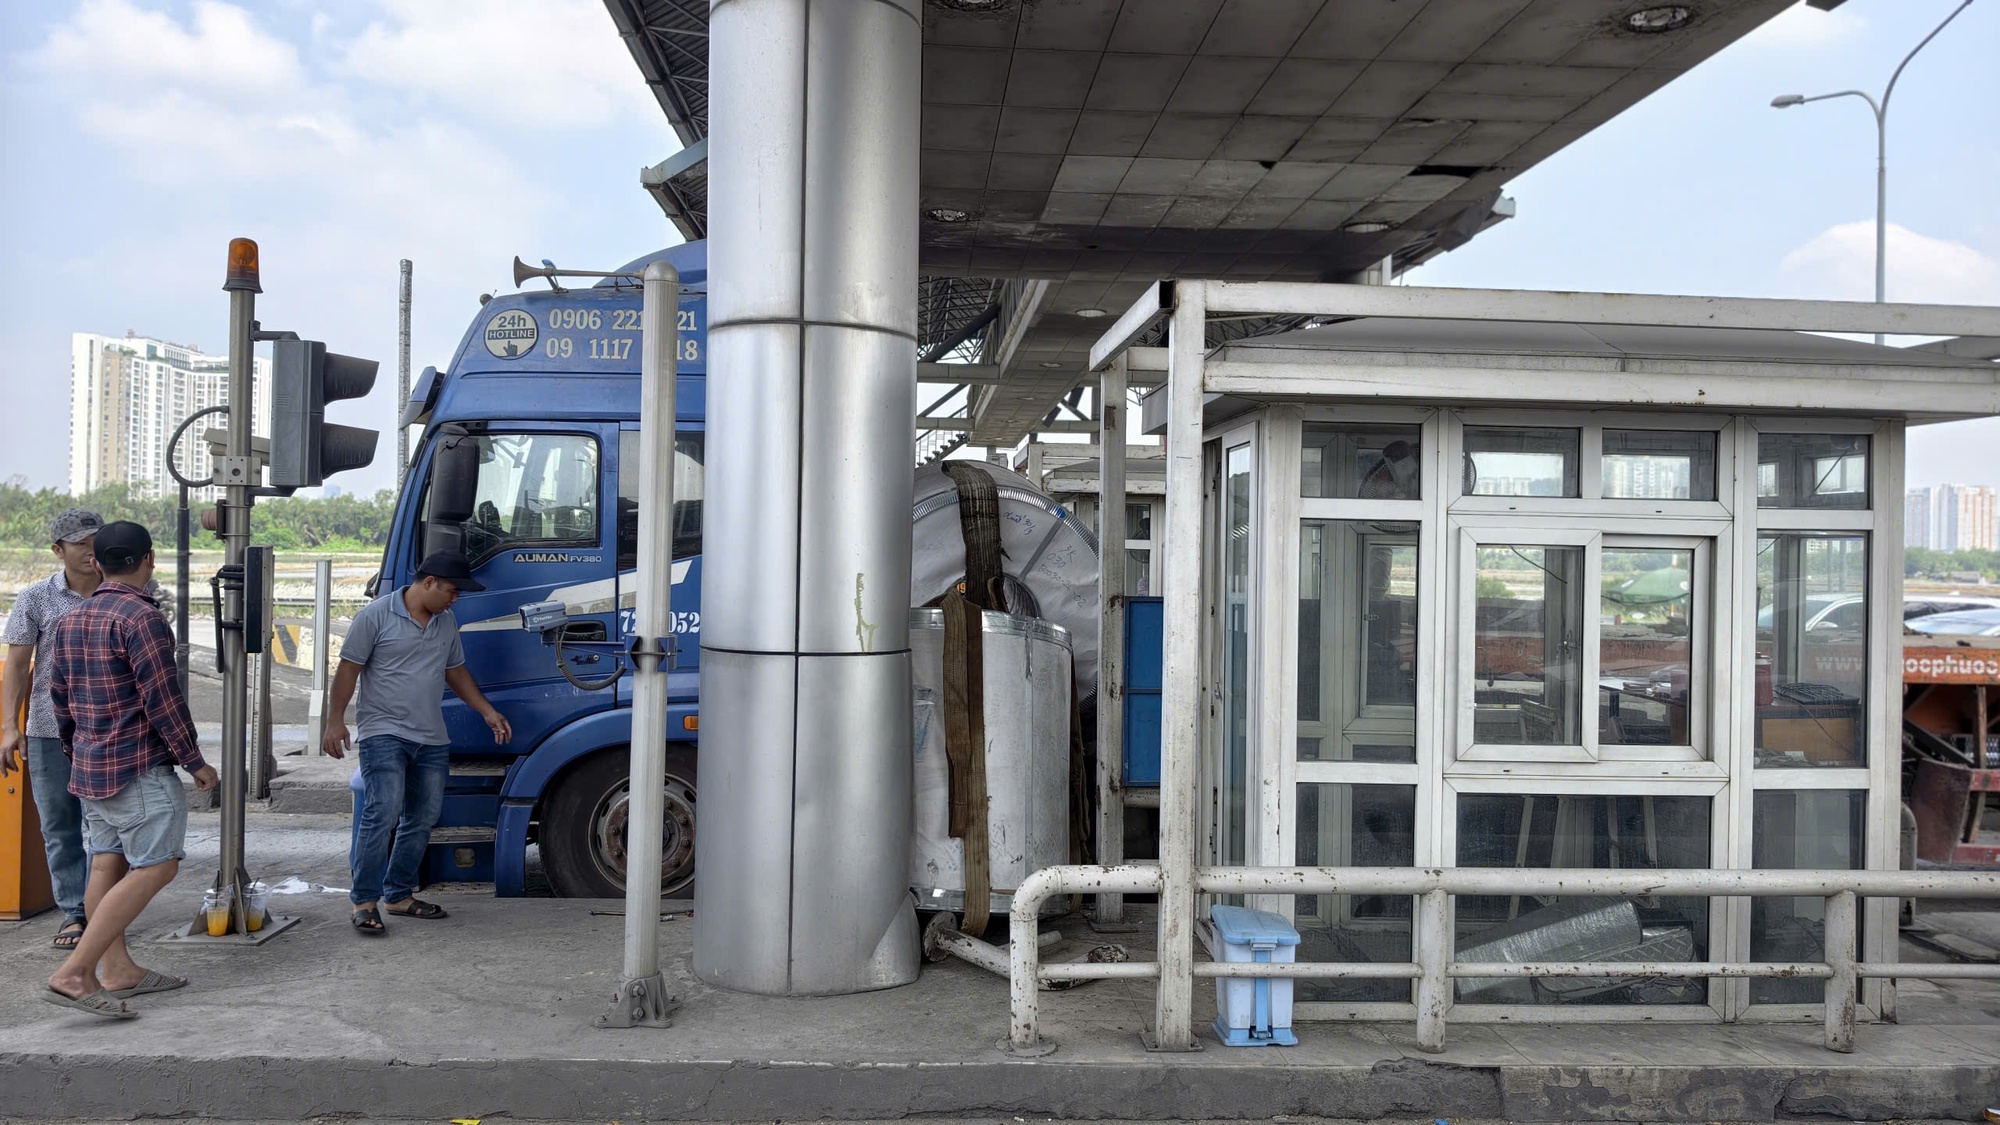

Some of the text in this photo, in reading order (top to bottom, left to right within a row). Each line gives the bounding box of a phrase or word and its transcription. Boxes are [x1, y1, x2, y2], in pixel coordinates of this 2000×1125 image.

[498, 315, 527, 328] 24h
[549, 308, 602, 330] 0906
[612, 309, 644, 331] 221
[489, 329, 534, 339] HOTLINE
[546, 337, 573, 358] 09
[589, 338, 633, 360] 1117
[514, 553, 568, 563] AUMAN
[1902, 655, 2000, 678] ocphuoc
